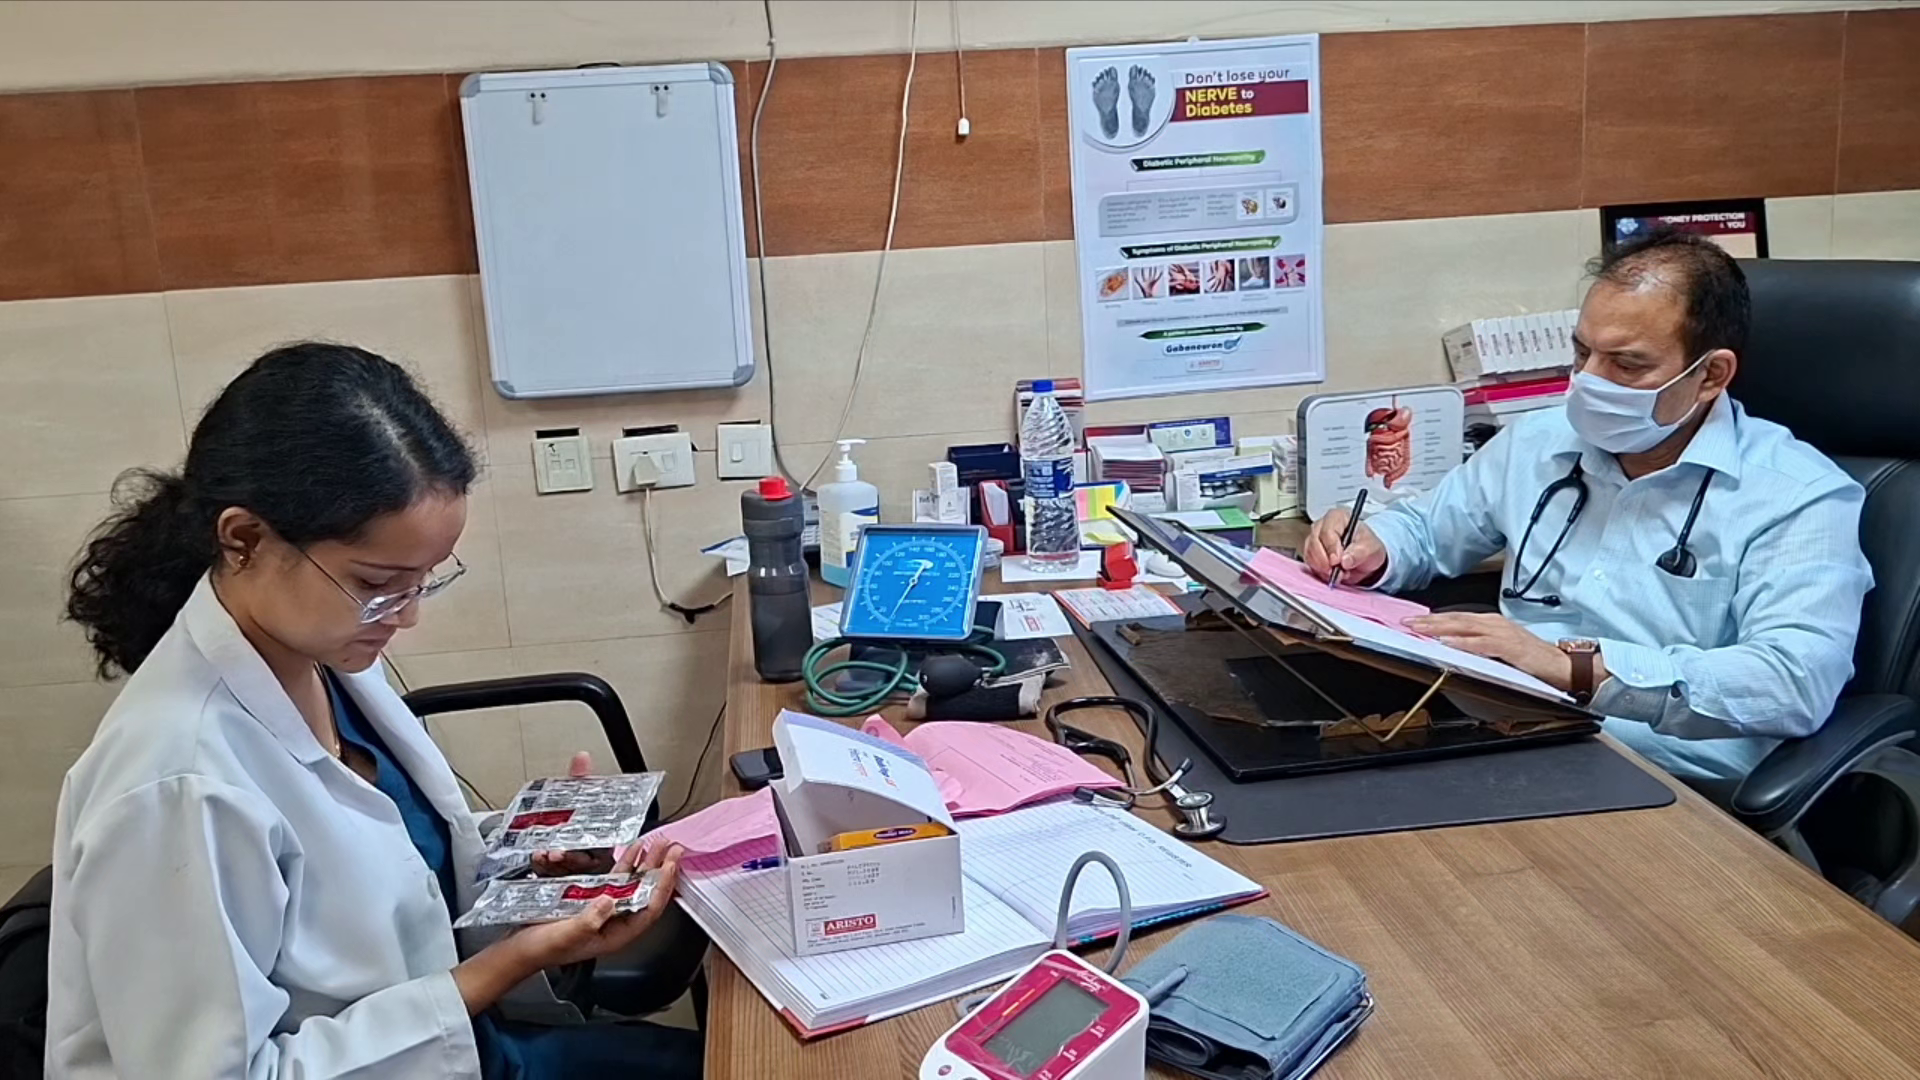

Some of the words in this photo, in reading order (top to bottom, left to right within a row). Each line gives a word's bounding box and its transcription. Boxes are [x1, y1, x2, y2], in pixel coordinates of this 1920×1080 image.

[1185, 71, 1223, 84] Don't
[1226, 70, 1255, 82] lose
[1258, 69, 1290, 84] your
[1185, 87, 1237, 102] NERVE
[1241, 88, 1255, 99] to
[1186, 102, 1252, 117] Diabetes
[1143, 158, 1174, 168] Diabetic
[1174, 156, 1212, 166] Peripheral
[1691, 212, 1745, 222] PROTECTION
[1726, 221, 1746, 229] YOU
[1131, 247, 1166, 256] Symptoms
[1174, 243, 1201, 252] Diabetic
[1201, 241, 1234, 250] Peripheral
[1235, 238, 1273, 248] Neuropathy
[1166, 342, 1223, 353] Gabaneuron
[826, 915, 874, 932] ARISTO
